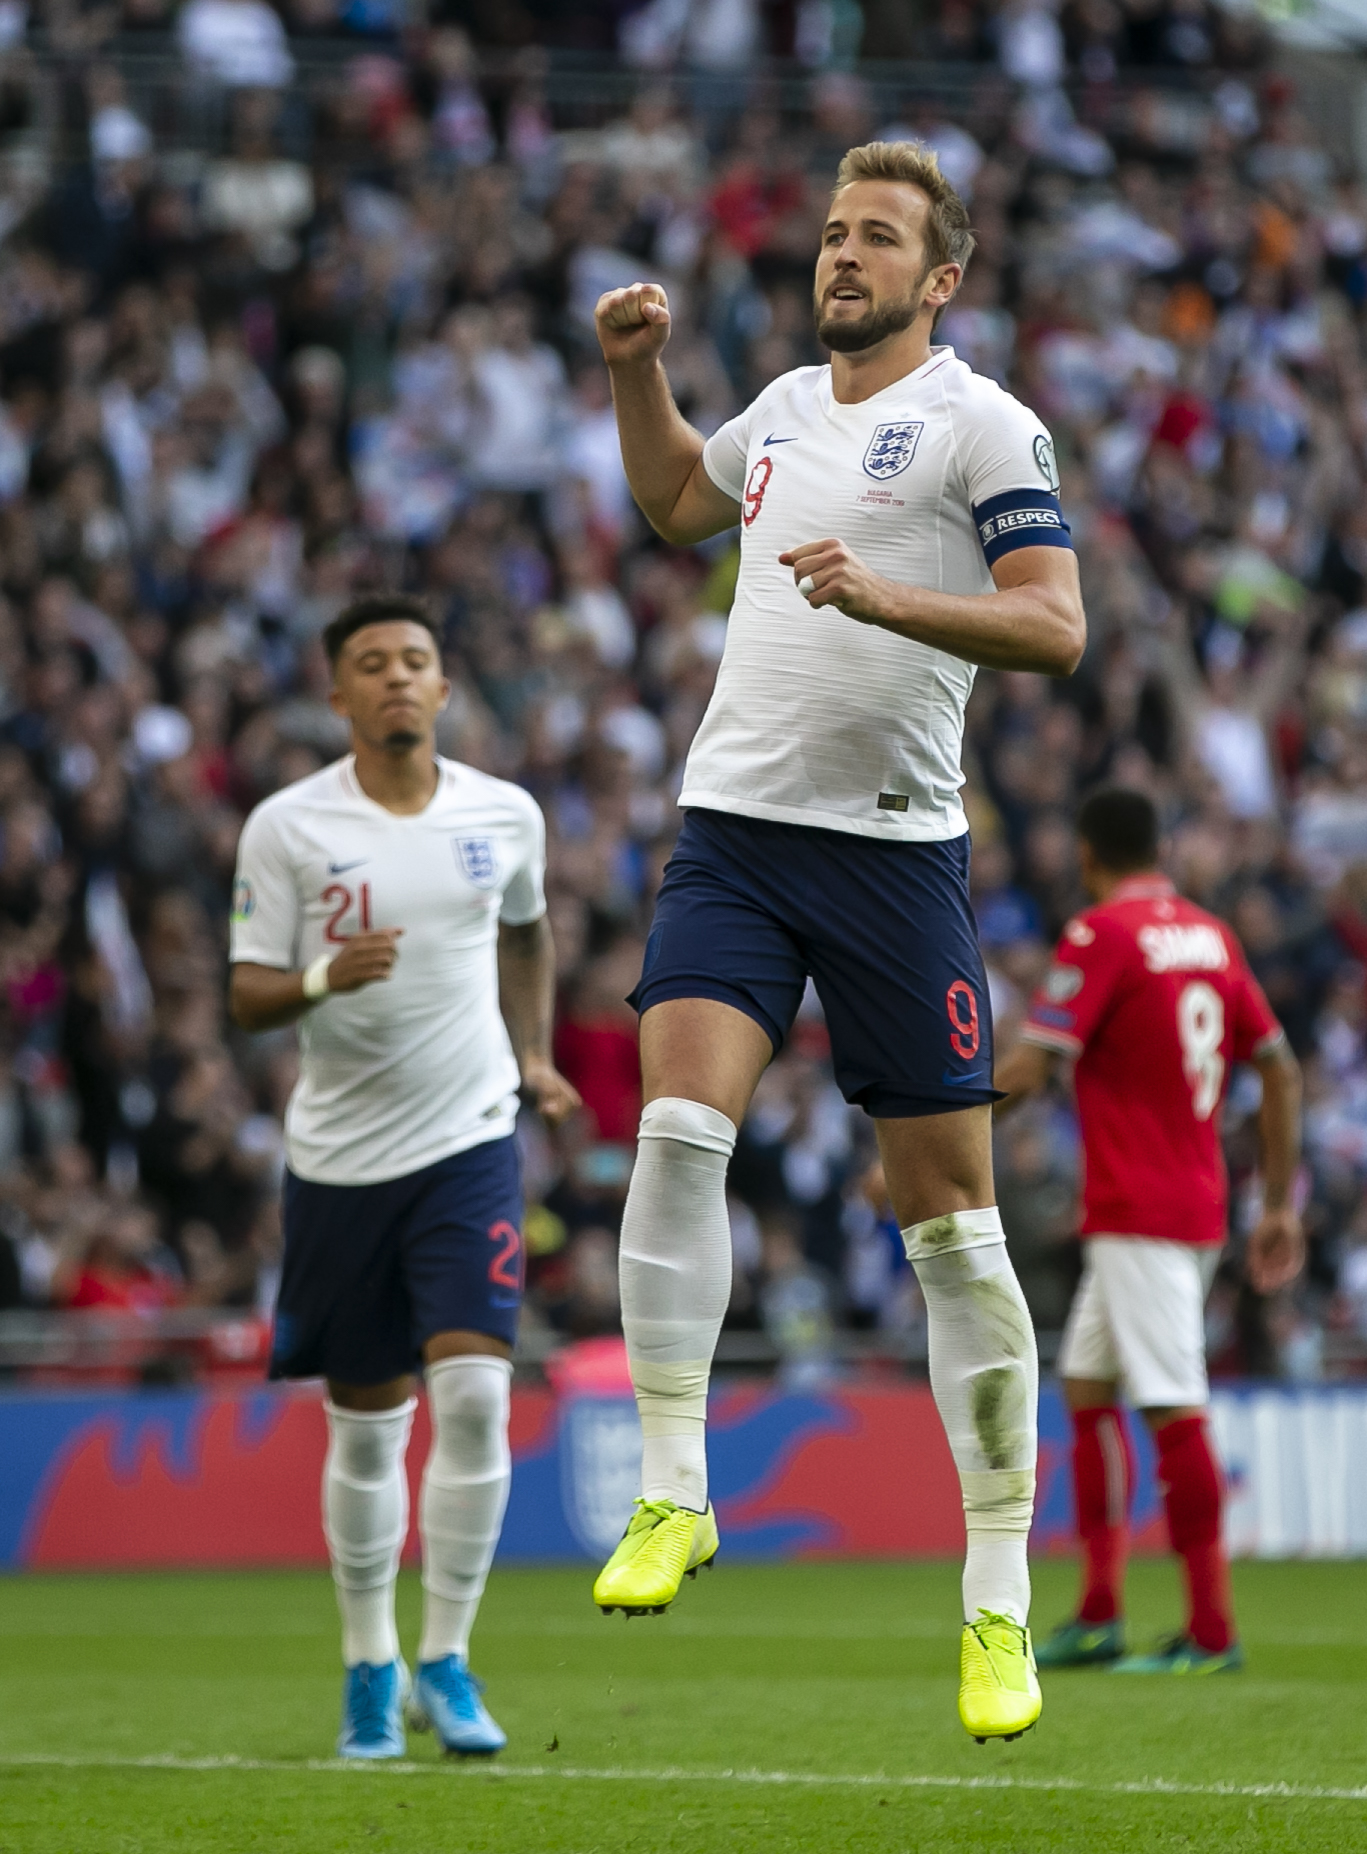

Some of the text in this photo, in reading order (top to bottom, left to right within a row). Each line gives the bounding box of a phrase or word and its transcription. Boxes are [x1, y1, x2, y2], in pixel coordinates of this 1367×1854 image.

[743, 456, 773, 527] 9
[997, 512, 1061, 530] RESPECT
[320, 881, 371, 944] 21
[946, 980, 980, 1060] 9
[1177, 981, 1225, 1121] 8
[488, 1220, 525, 1290] 2
